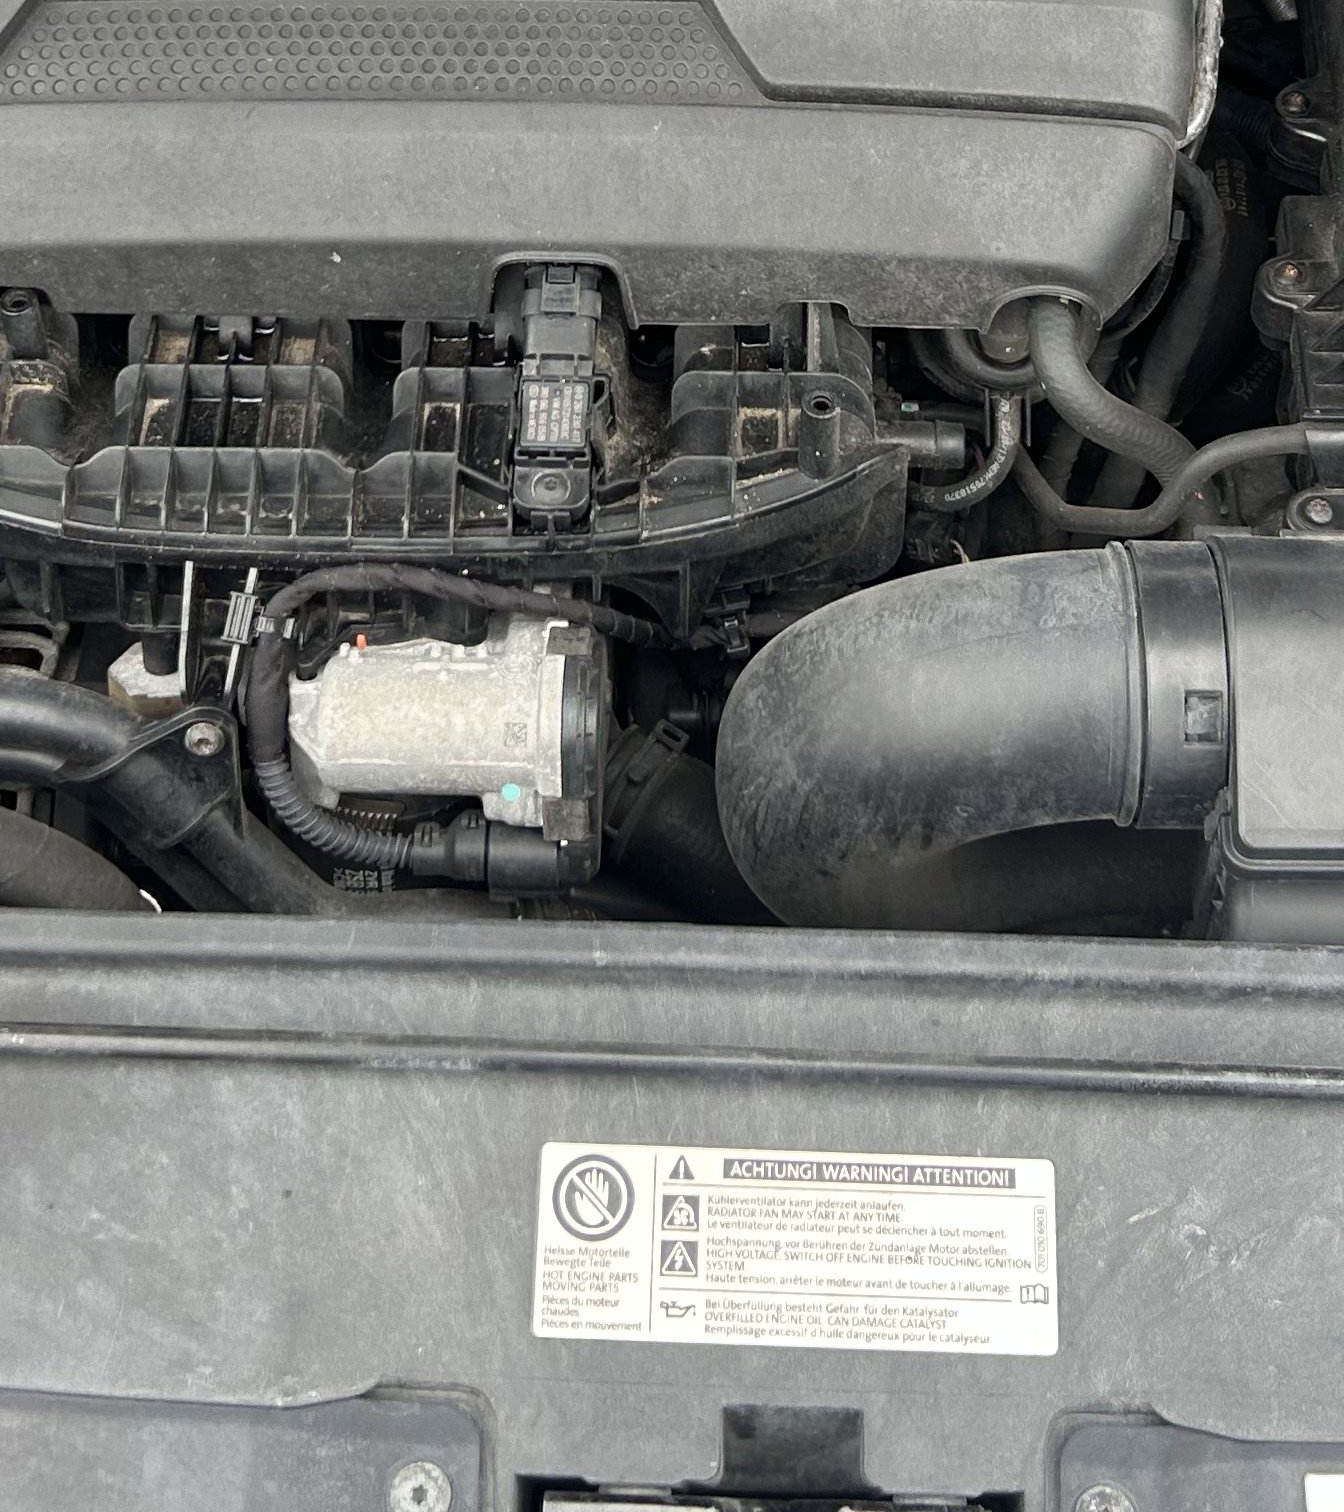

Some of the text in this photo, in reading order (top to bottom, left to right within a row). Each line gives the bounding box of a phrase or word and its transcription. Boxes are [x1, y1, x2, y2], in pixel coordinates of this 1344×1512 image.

[707, 1195, 787, 1207] Kühlerventilator
[789, 1196, 813, 1208] kann
[815, 1197, 857, 1210] jederzeit
[707, 1207, 757, 1217] RADIATOR
[759, 1208, 779, 1219] FAN
[781, 1208, 805, 1219] MAY
[807, 1209, 835, 1221] START
[838, 1211, 851, 1221] AT
[853, 1211, 874, 1222] ANY
[707, 1220, 717, 1229] Le
[720, 1220, 773, 1231] ventilateur
[775, 1221, 788, 1231] de
[790, 1222, 834, 1233] radiateur
[837, 1223, 861, 1235] peut
[862, 1225, 873, 1233] se
[876, 1225, 928, 1236] déclencher
[931, 1227, 937, 1236] à
[939, 1227, 960, 1237] tout
[544, 1245, 630, 1258] Heisse Motorteile
[785, 1241, 800, 1249] vor
[803, 1239, 848, 1251] Berühren
[849, 1240, 866, 1252] der
[868, 1241, 927, 1257] Zündanlage
[929, 1243, 959, 1255] Motor
[543, 1255, 612, 1269] Bewegte Teile
[706, 1248, 733, 1259] HIGH
[783, 1251, 824, 1261] SWITCH
[825, 1252, 844, 1263] OFF
[846, 1253, 885, 1265] ENGINE
[887, 1254, 925, 1266] BEFORE
[927, 1255, 983, 1268] TOUCHING
[985, 1258, 1032, 1269] IGNITION
[706, 1260, 745, 1271] SYSTEM
[542, 1270, 639, 1283] HOT ENGINE PARTS
[706, 1273, 737, 1284] Haute
[779, 1274, 814, 1286] arrêter
[815, 1276, 824, 1287] le
[827, 1277, 862, 1288] moteur
[865, 1279, 893, 1289] avant
[896, 1278, 907, 1290] de
[910, 1280, 947, 1291] toucher
[950, 1281, 956, 1291] à
[542, 1280, 619, 1293] MOVING PARTS
[542, 1294, 620, 1308] Pièces du moteur
[705, 1298, 721, 1309] Bei
[722, 1297, 782, 1314] Überfüllung
[785, 1301, 823, 1312] besteht
[825, 1302, 860, 1314] Gefahr
[864, 1304, 878, 1315] für
[881, 1305, 899, 1316] den
[541, 1305, 580, 1317] chaudes
[541, 1318, 642, 1331] Pièces en mouvement
[704, 1311, 947, 1329] OVERFILLED ENGINE OIL CAN DAMAGE CATALYST
[704, 1324, 766, 1338] Remplissage
[768, 1327, 808, 1338] excessif
[846, 1328, 899, 1342] dangereux
[902, 1332, 926, 1344] pour
[929, 1332, 937, 1342] le
[939, 1332, 990, 1346] catalyseur
